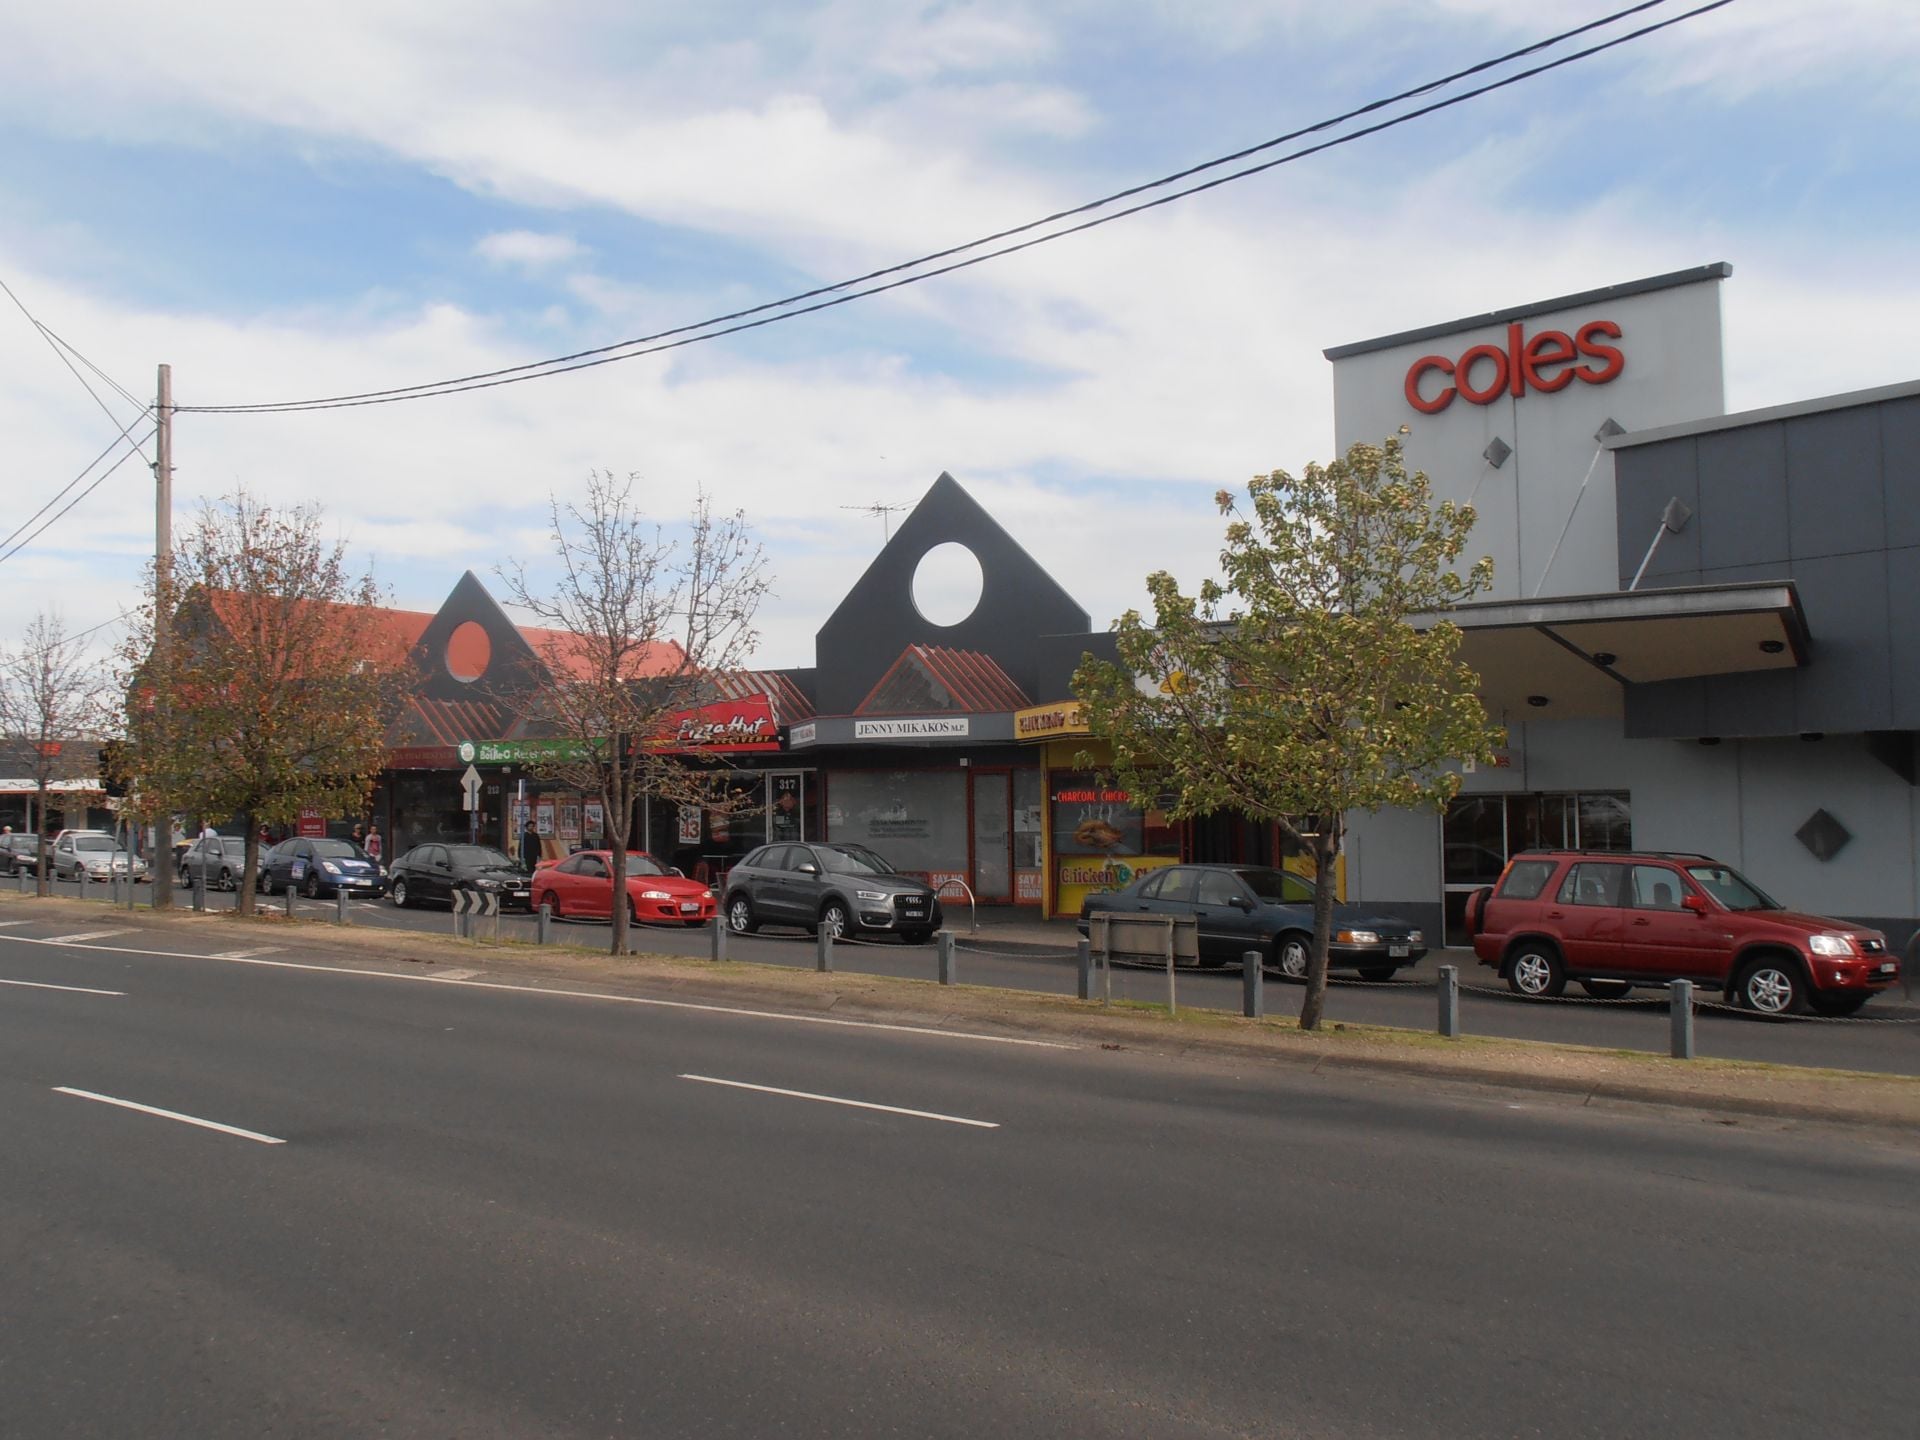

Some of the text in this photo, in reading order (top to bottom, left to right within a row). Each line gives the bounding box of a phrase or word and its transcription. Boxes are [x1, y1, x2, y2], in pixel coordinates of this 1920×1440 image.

[1404, 320, 1625, 415] coles
[676, 719, 725, 741] Pizza
[725, 714, 769, 735] Hut
[858, 722, 898, 735] JENNY
[898, 721, 949, 734] MIKAKOS
[779, 780, 796, 790] 317
[1057, 791, 1131, 803] CHARCOAL CHICKE
[302, 809, 322, 818] LEAS
[932, 874, 964, 884] SAY NO
[1018, 874, 1035, 885] SAY
[1018, 888, 1042, 898] TUNN
